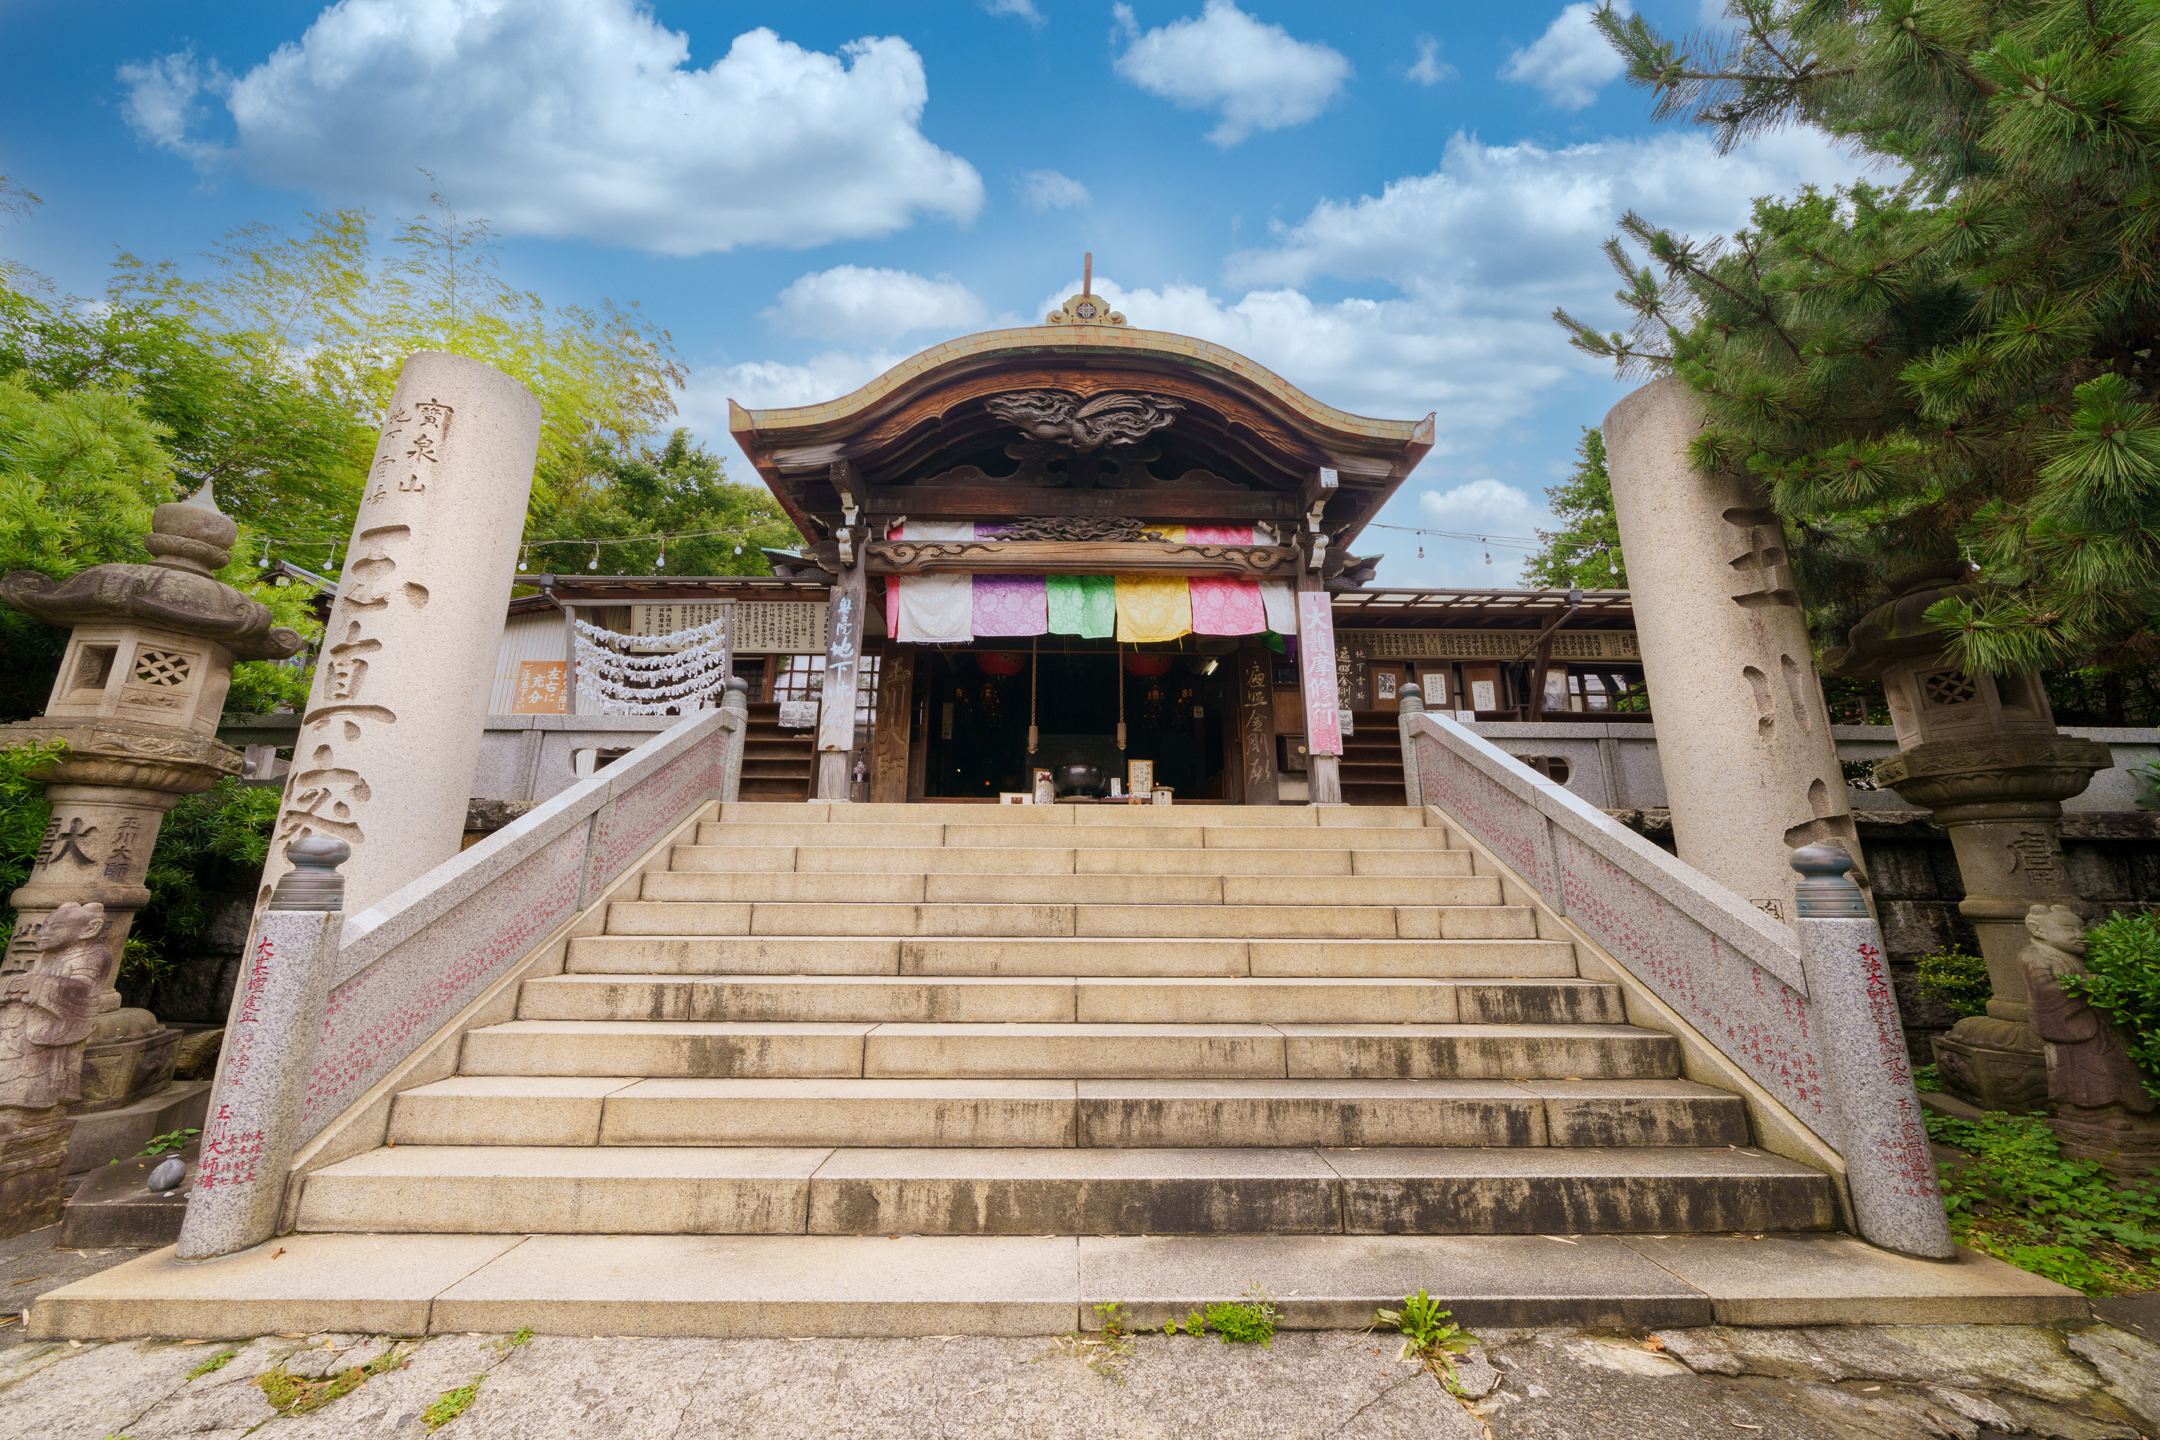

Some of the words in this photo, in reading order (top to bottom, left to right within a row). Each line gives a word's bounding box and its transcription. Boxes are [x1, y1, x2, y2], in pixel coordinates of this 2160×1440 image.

[1304, 606, 1335, 726] 大護摩修行
[527, 674, 546, 704] 充分
[544, 667, 562, 703] 左右に
